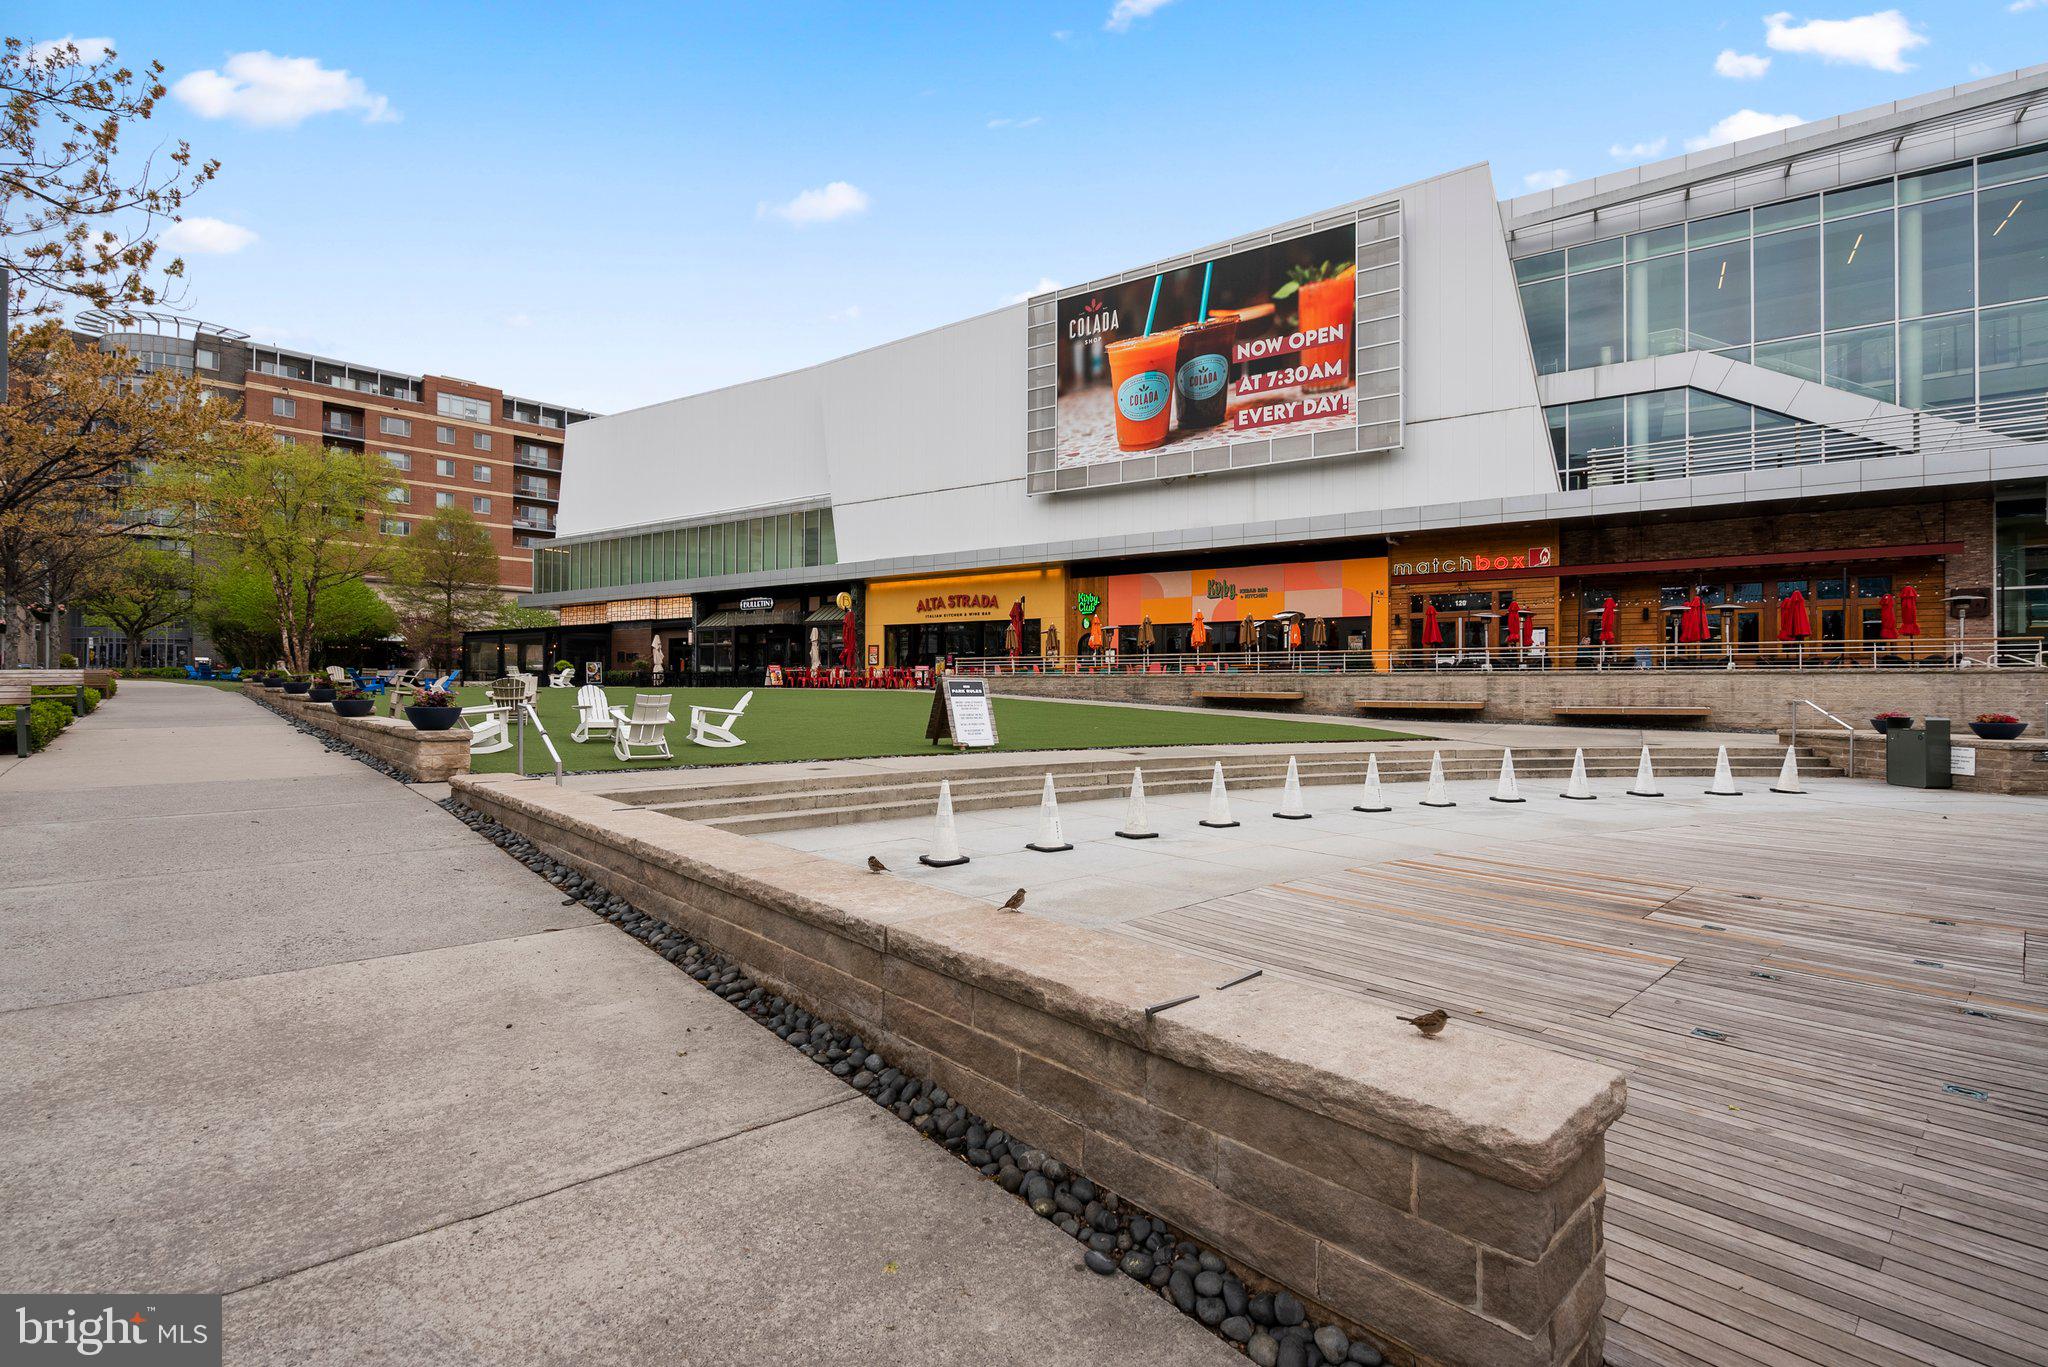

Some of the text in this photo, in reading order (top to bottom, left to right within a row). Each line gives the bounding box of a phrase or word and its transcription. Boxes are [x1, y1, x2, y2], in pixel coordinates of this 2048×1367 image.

[1069, 310, 1119, 339] COLADA
[1084, 337, 1102, 345] SHOP
[1237, 324, 1344, 360] NOW OPEN
[1190, 371, 1218, 387] COLADA
[1239, 359, 1342, 393] AT 7:30AM
[1129, 389, 1159, 407] COLADA
[1238, 394, 1349, 426] EVERY DAY!
[1393, 554, 1525, 576] matchbox
[1207, 579, 1236, 600] Kirby
[742, 600, 771, 608] BULLETIN
[916, 594, 999, 612] ALTA STRADA
[1078, 593, 1099, 605] Kirby
[1078, 602, 1095, 612] Club
